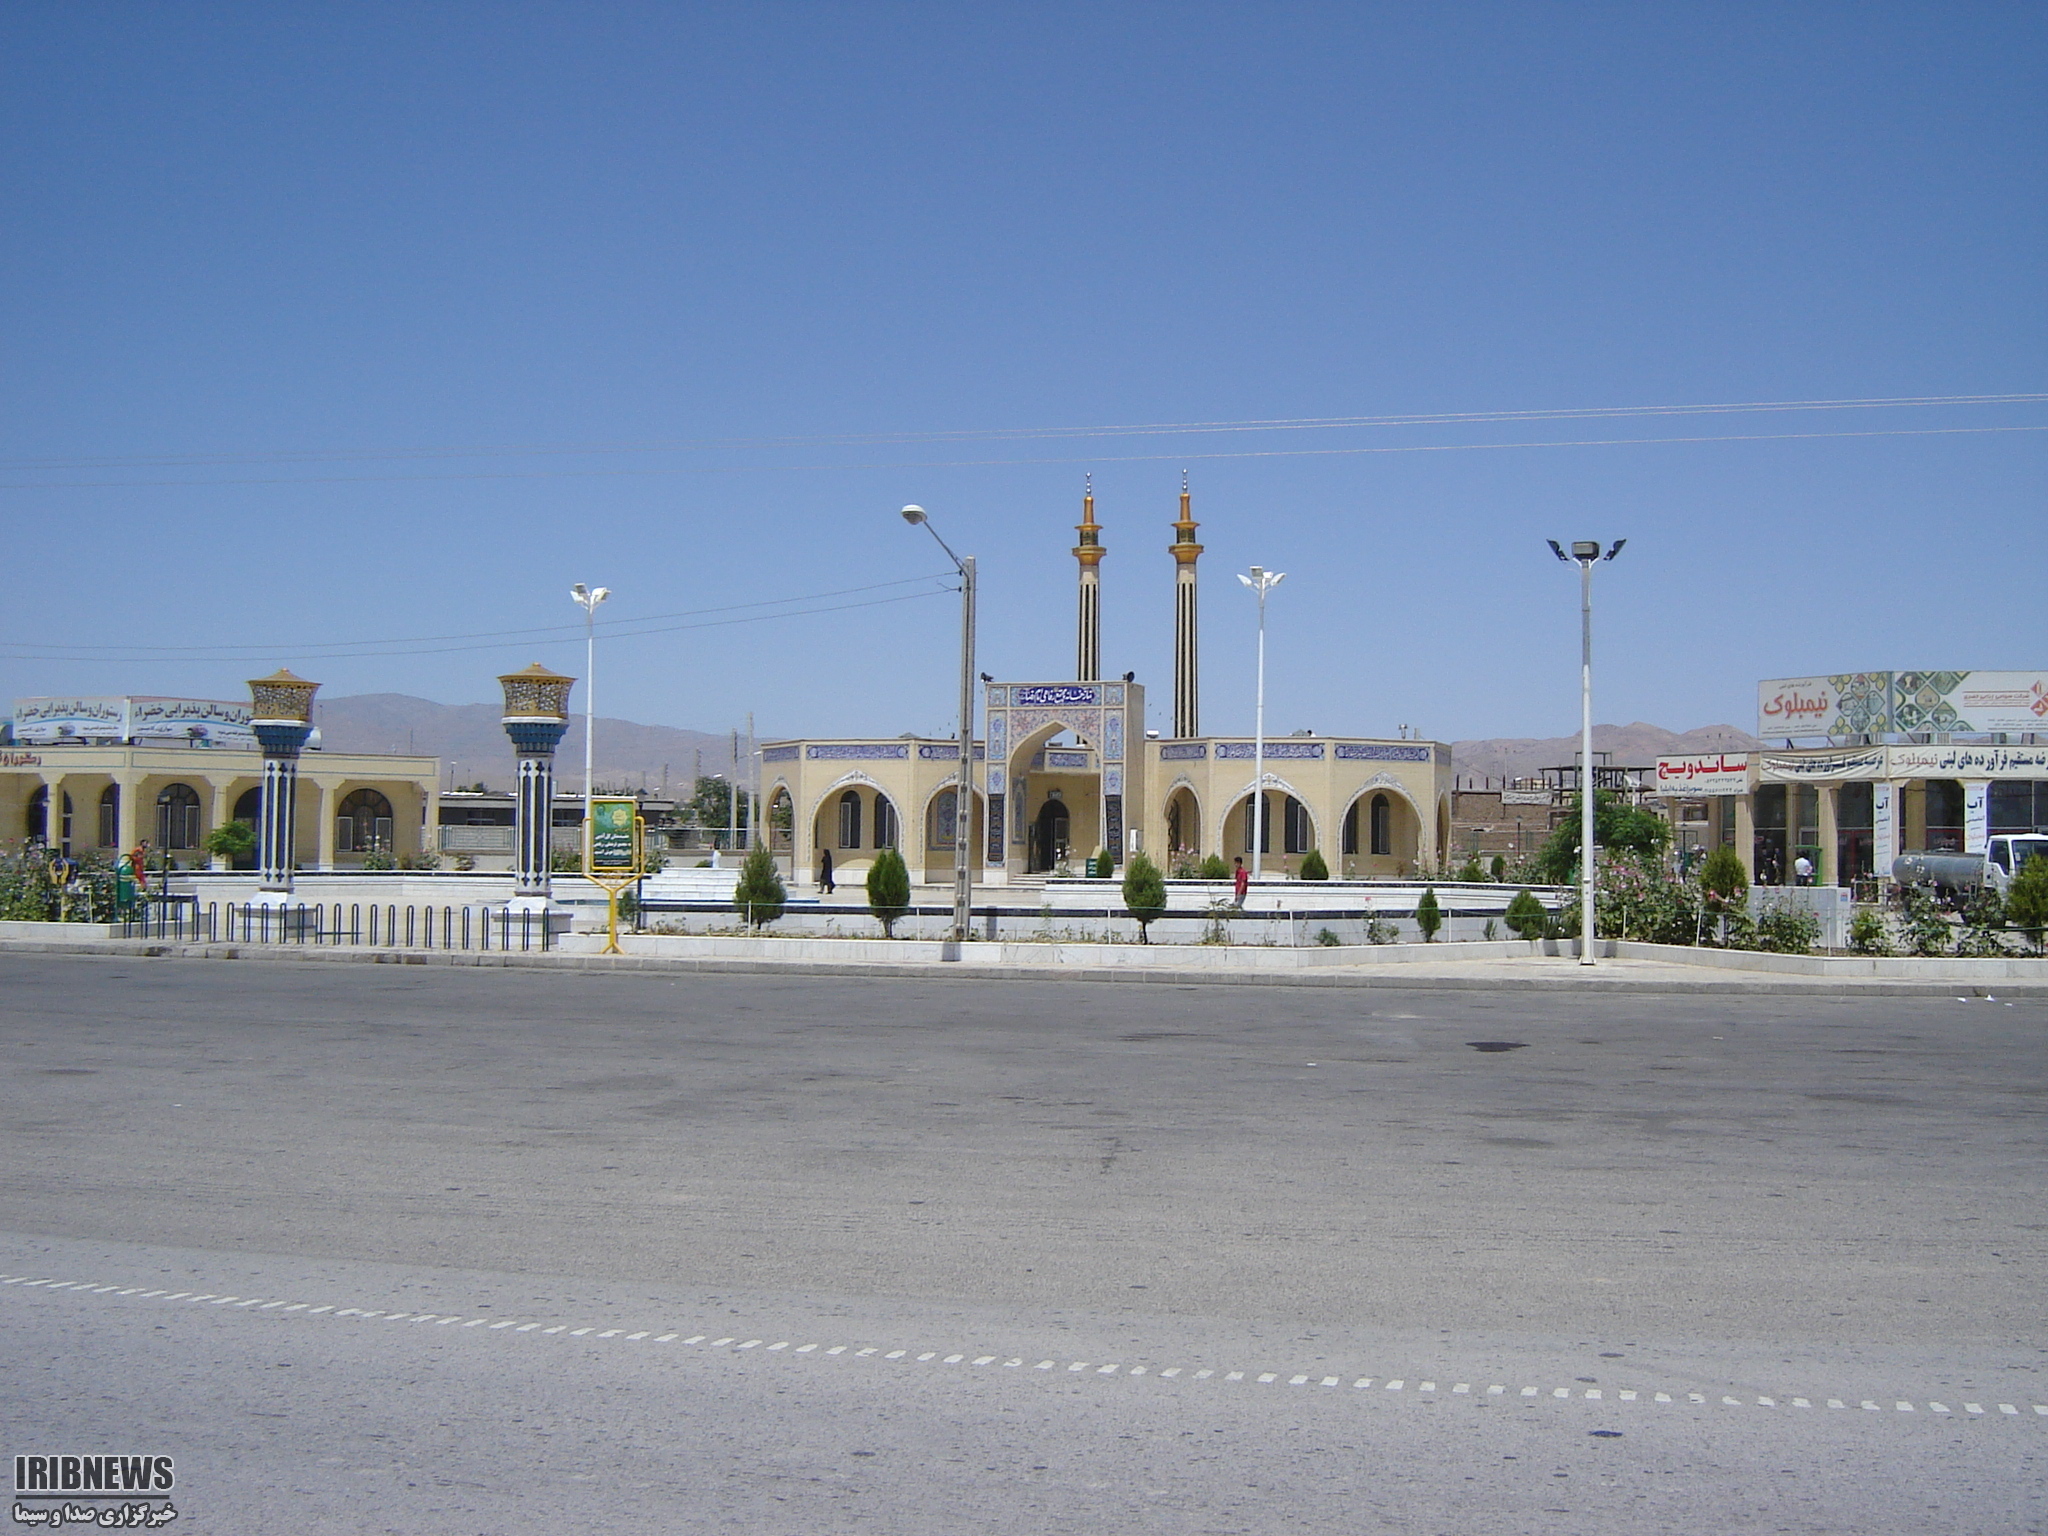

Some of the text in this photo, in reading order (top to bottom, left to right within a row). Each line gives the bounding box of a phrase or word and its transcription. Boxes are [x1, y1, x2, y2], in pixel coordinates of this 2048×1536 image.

[40, 701, 68, 718] پذیرایی
[68, 701, 88, 716] سالن
[93, 703, 122, 722] رستوران
[165, 702, 201, 718] پذیرایی
[201, 704, 223, 719] سالن
[1763, 691, 1828, 719] نیمبلوک
[1658, 755, 1748, 780] ساندویچ
[1890, 752, 1938, 770] نیمبلوک
[1939, 750, 1957, 769] لبنی
[1957, 751, 1973, 770] های
[2009, 751, 2034, 770] مستقیم
